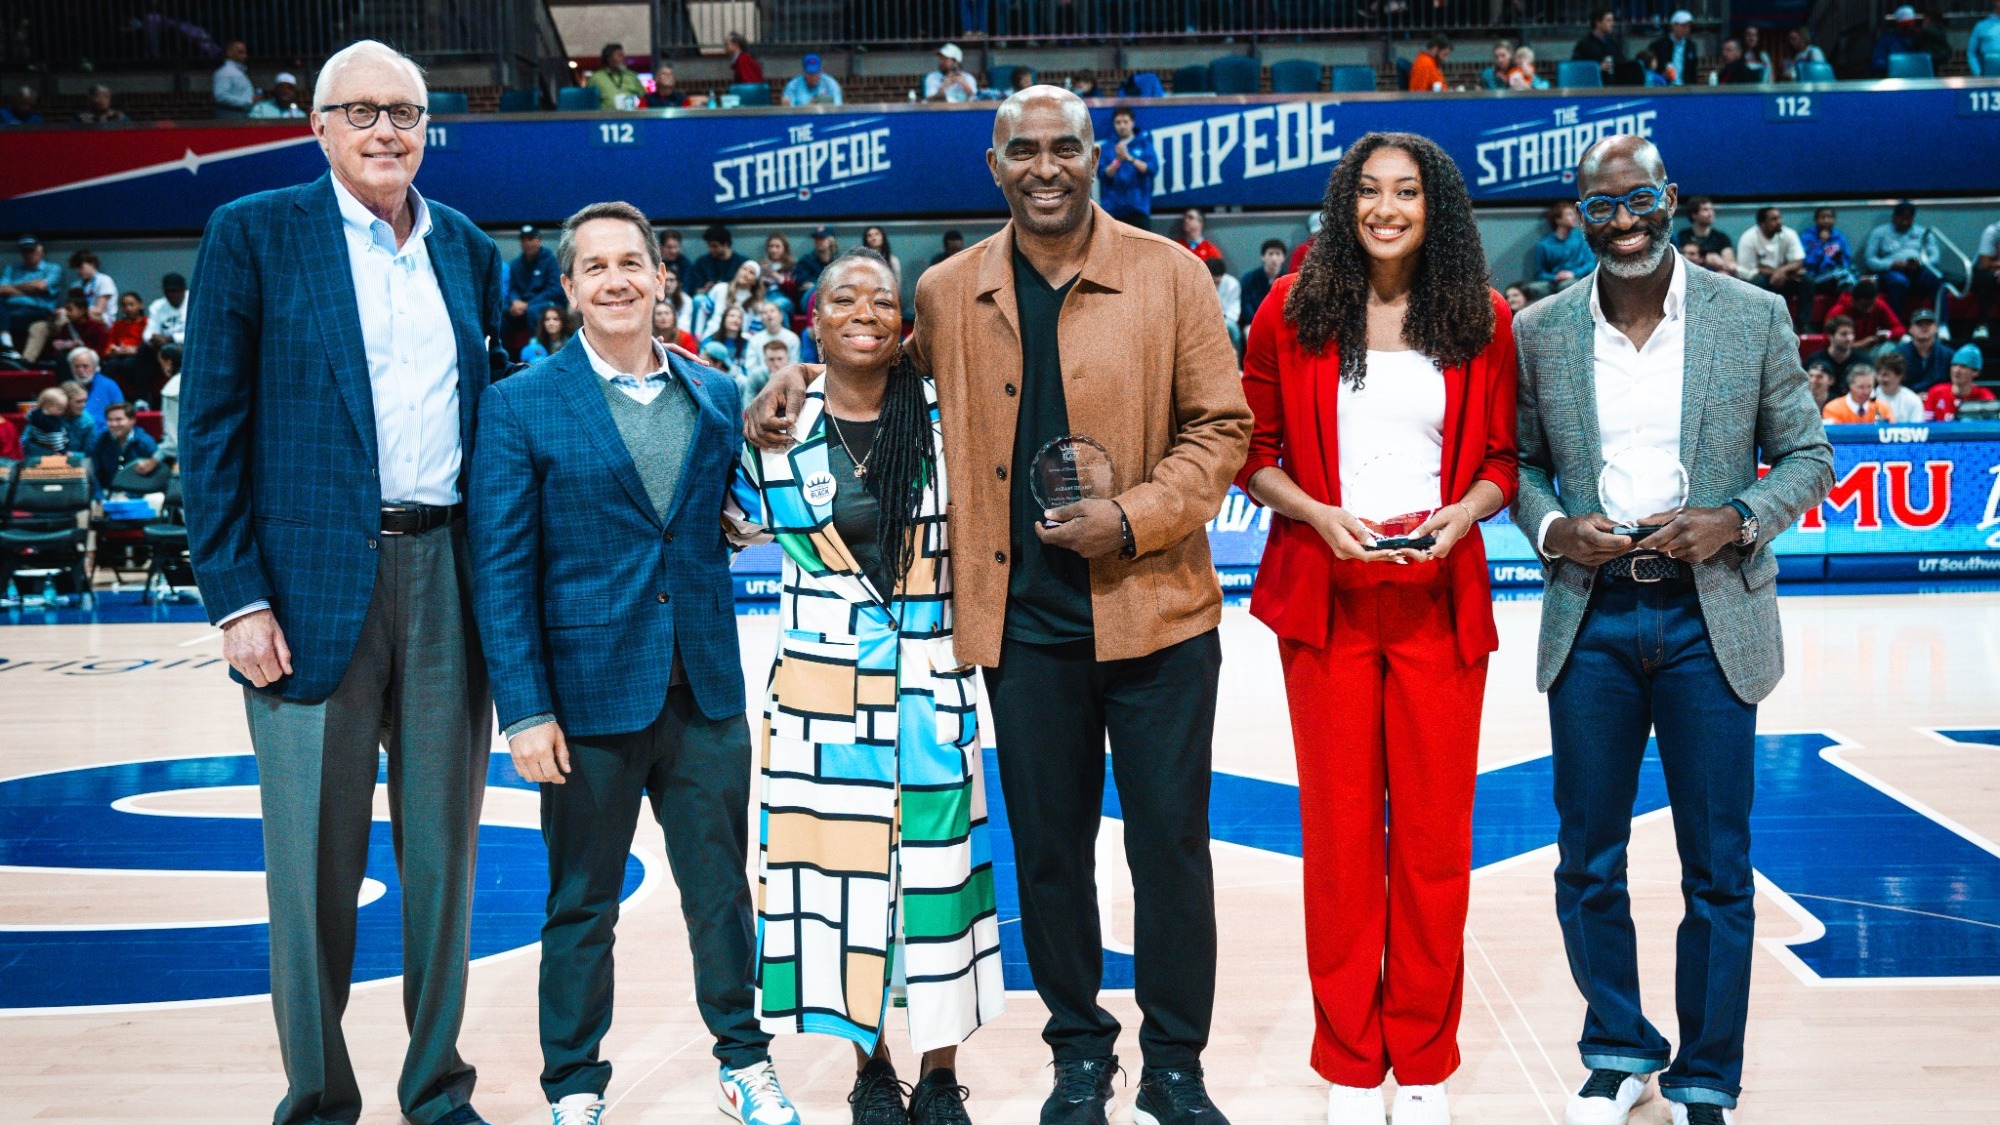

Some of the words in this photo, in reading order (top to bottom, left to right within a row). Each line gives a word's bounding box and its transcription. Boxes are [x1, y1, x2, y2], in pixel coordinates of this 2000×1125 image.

[1553, 105, 1580, 127] THE
[1776, 96, 1812, 117] 112
[424, 127, 447, 147] 11
[599, 123, 635, 143] 112
[787, 123, 814, 144] THE
[713, 128, 892, 203] STAMPEDE
[1878, 427, 1930, 444] UTSW
[1757, 459, 1954, 533] MU
